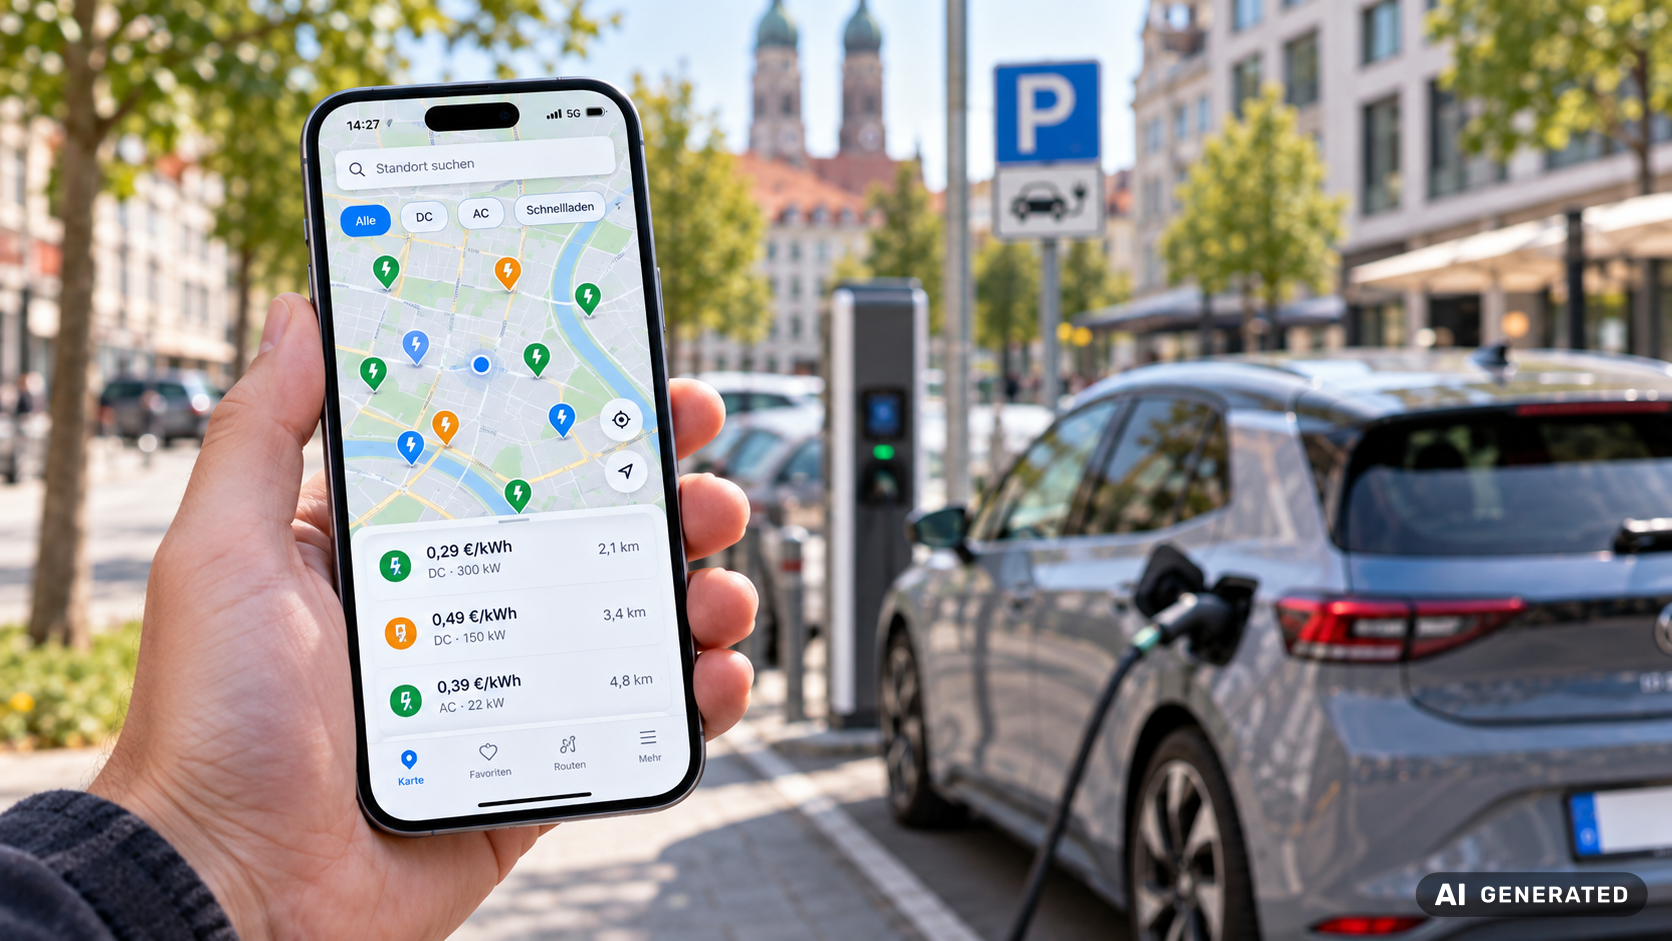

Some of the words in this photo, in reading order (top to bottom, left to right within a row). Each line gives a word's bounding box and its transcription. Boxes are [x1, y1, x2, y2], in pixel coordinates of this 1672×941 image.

[566, 108, 581, 119] 5G
[1016, 73, 1076, 154] P
[346, 119, 380, 131] 14:27
[376, 161, 429, 175] Standort
[431, 159, 475, 171] suchen
[472, 208, 490, 219] AC
[526, 202, 595, 216] Schnellladen
[355, 215, 377, 227] Alle
[416, 211, 433, 223] DC
[426, 544, 459, 561] 0,29
[463, 539, 513, 558] €/kWh
[598, 542, 616, 556] 2,1
[620, 541, 640, 553] km
[428, 567, 446, 579] DC
[457, 564, 480, 577] 300
[482, 562, 501, 574] kW
[432, 610, 465, 628] 0,49
[468, 606, 518, 625] €/kWh
[603, 607, 624, 623] 3,4
[626, 607, 647, 619] km
[433, 634, 452, 646] DC
[463, 631, 485, 643] 150
[487, 629, 506, 641] kW
[437, 678, 470, 696] 0,39
[473, 673, 522, 692] €/kWh
[609, 674, 631, 689] 4,8
[633, 673, 653, 686] km
[439, 701, 457, 714] AC
[467, 699, 483, 711] 22
[486, 697, 505, 709] kW
[638, 753, 662, 763] Mehr
[469, 768, 512, 779] Favoriten
[553, 761, 587, 771] Routen
[397, 776, 425, 787] Karte
